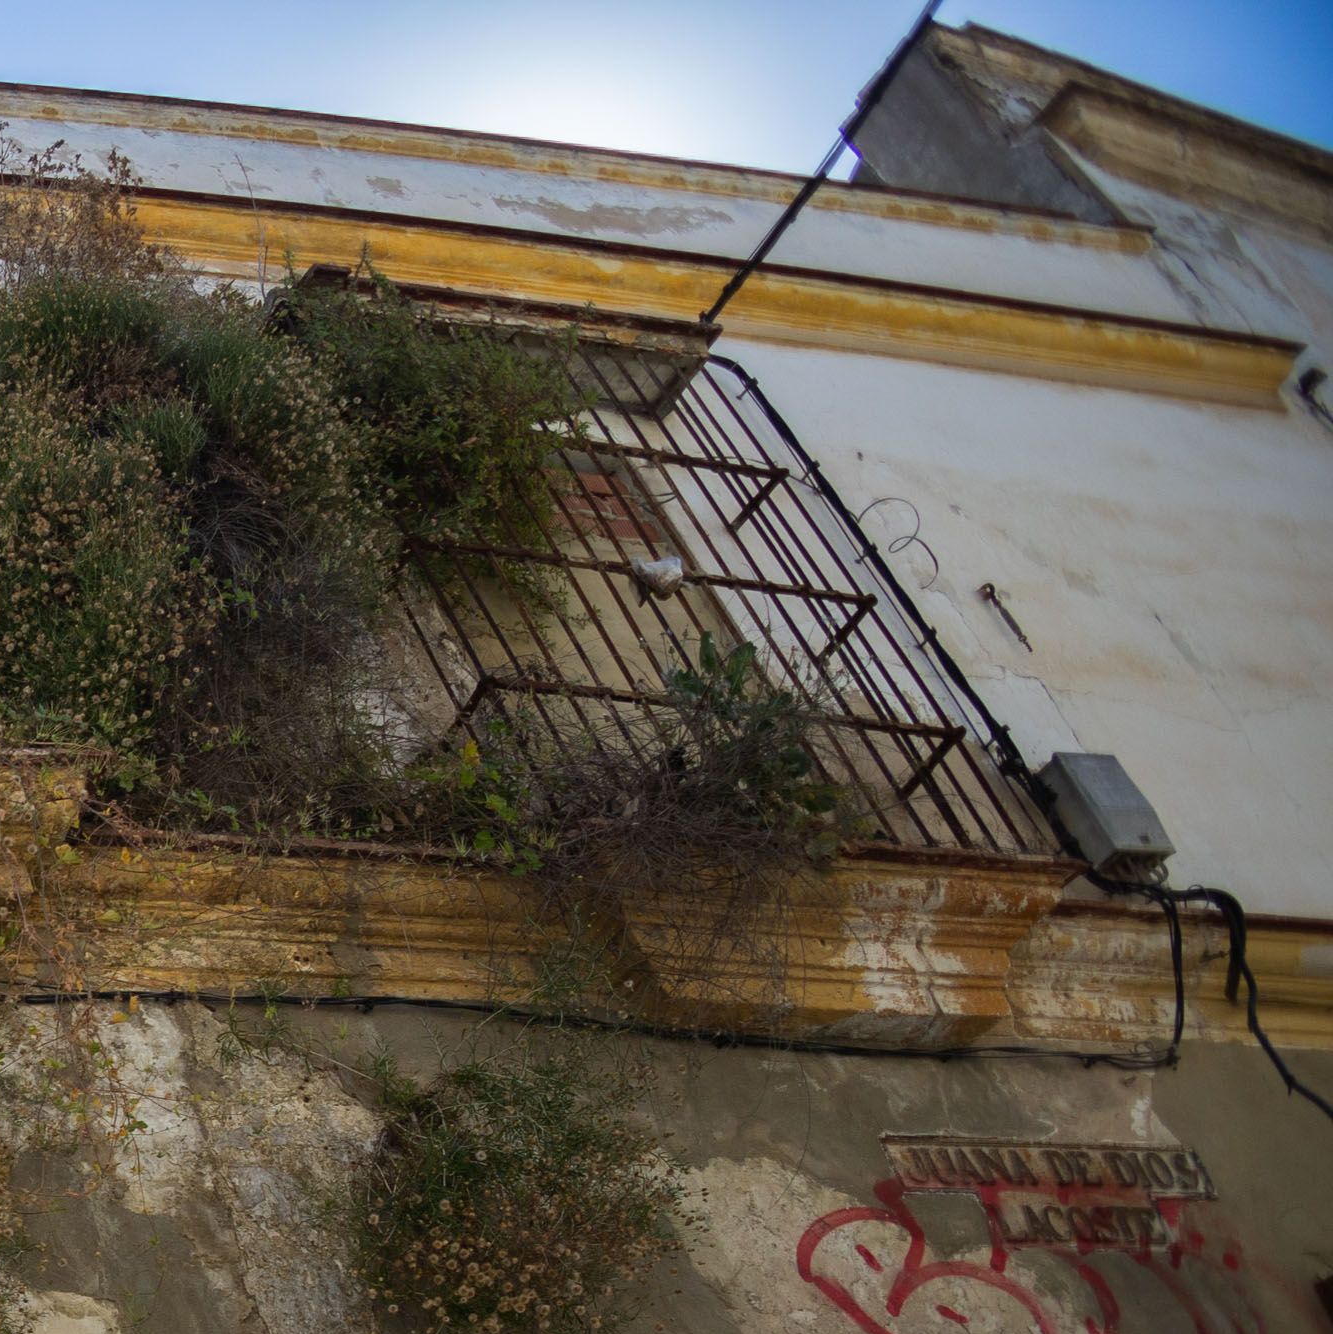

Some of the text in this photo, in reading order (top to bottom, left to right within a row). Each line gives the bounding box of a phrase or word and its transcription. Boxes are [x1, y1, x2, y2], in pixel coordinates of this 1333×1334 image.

[903, 1145, 1205, 1192] JUANA DE DIOS
[995, 1204, 1170, 1246] LACOSTE
